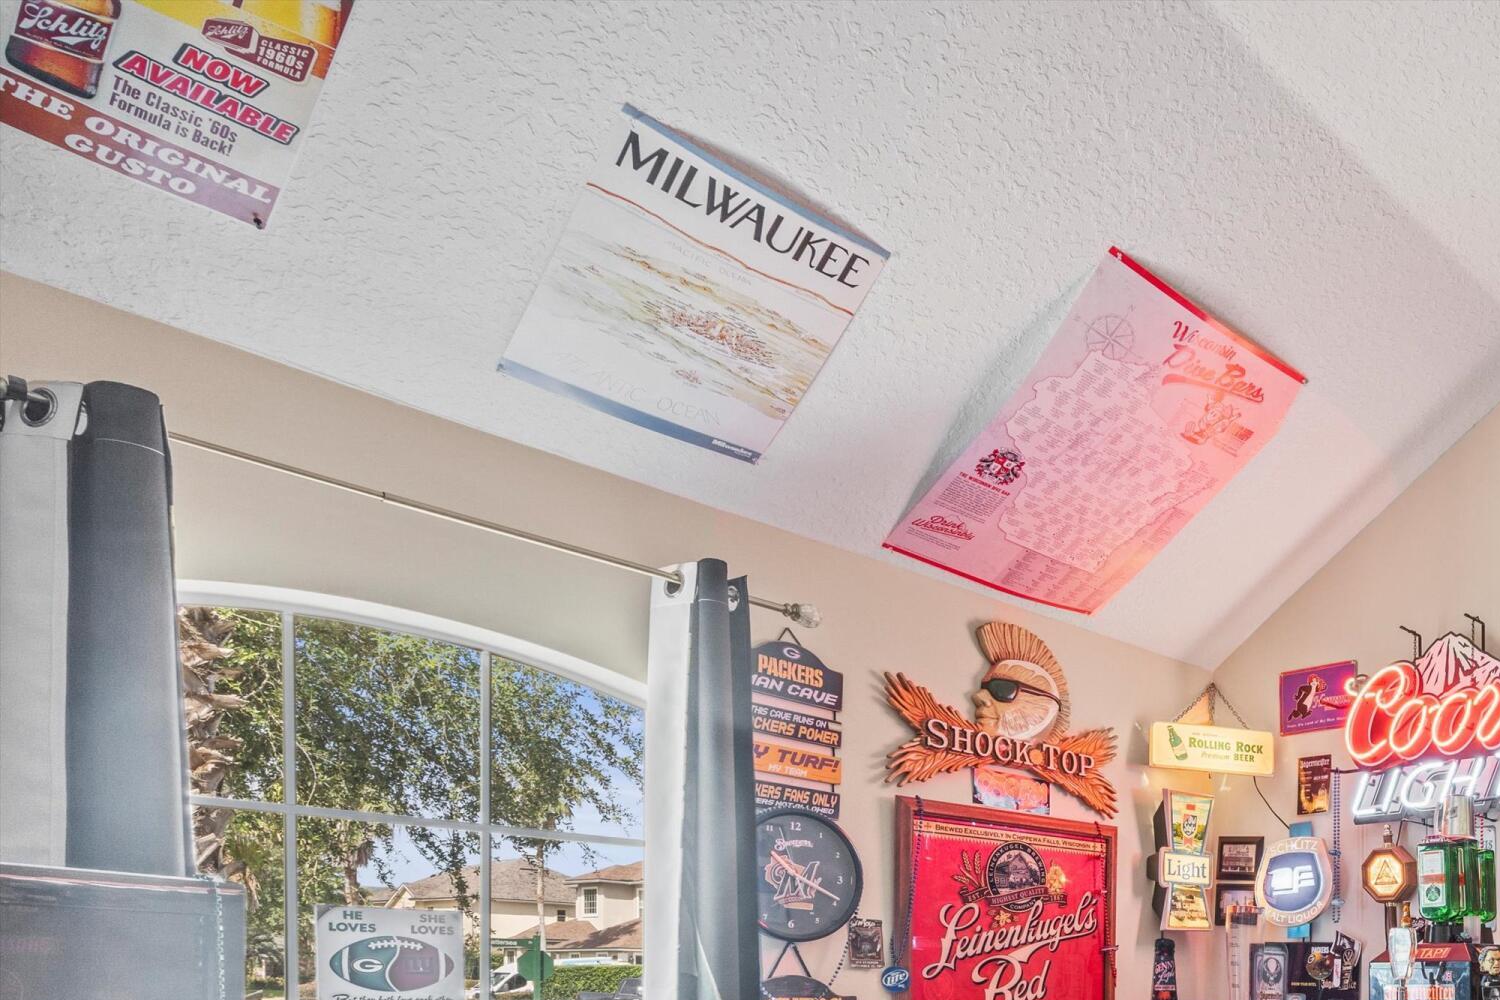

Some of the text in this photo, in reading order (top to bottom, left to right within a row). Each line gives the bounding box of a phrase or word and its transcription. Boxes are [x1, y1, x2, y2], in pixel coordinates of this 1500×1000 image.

[19, 3, 107, 52] Schlitz
[206, 21, 250, 40] Schlitz
[257, 46, 304, 71] 1960s
[259, 39, 310, 58] CLASSIC
[180, 46, 267, 96] NOW
[255, 56, 302, 79] FORMULA
[112, 75, 141, 101] The
[145, 89, 203, 128] Classic
[119, 54, 299, 143] AVAILABLE
[109, 92, 234, 156] Formula is Back!
[64, 134, 197, 196] GUSTO
[84, 116, 272, 203] ORIGINAL
[615, 129, 870, 289] MILWAUKEE
[1214, 364, 1264, 403] Bars
[758, 654, 824, 688] PACKERS
[787, 684, 839, 706] CAVE
[769, 709, 827, 729] CAVE RUNS ON
[798, 724, 839, 746] POWER
[1188, 737, 1264, 754] ROLLING ROCK
[925, 719, 1096, 778] SHOCK TOP
[1233, 753, 1255, 762] BEER
[778, 749, 840, 774] TURF!
[783, 788, 838, 808] FANS ONLY
[790, 822, 802, 831] 12
[935, 824, 963, 834] BREWED
[964, 827, 1004, 839] EXCLUSIVELY
[1012, 834, 1042, 843] CHIPPEWA
[1062, 841, 1091, 849] WISCONSIN
[989, 843, 1045, 884] LEINENKUGEL BREWING
[1167, 858, 1207, 880] Light
[837, 876, 843, 885] 3
[992, 887, 1045, 904] HIGHEST QUALITY
[1009, 900, 1036, 910] COMPANY
[342, 910, 363, 921] HE
[419, 914, 446, 924] SHE
[788, 920, 794, 928] 6
[328, 922, 377, 933] LOVES
[410, 924, 455, 936] LOVES
[922, 891, 1098, 979] Leinenkugel's
